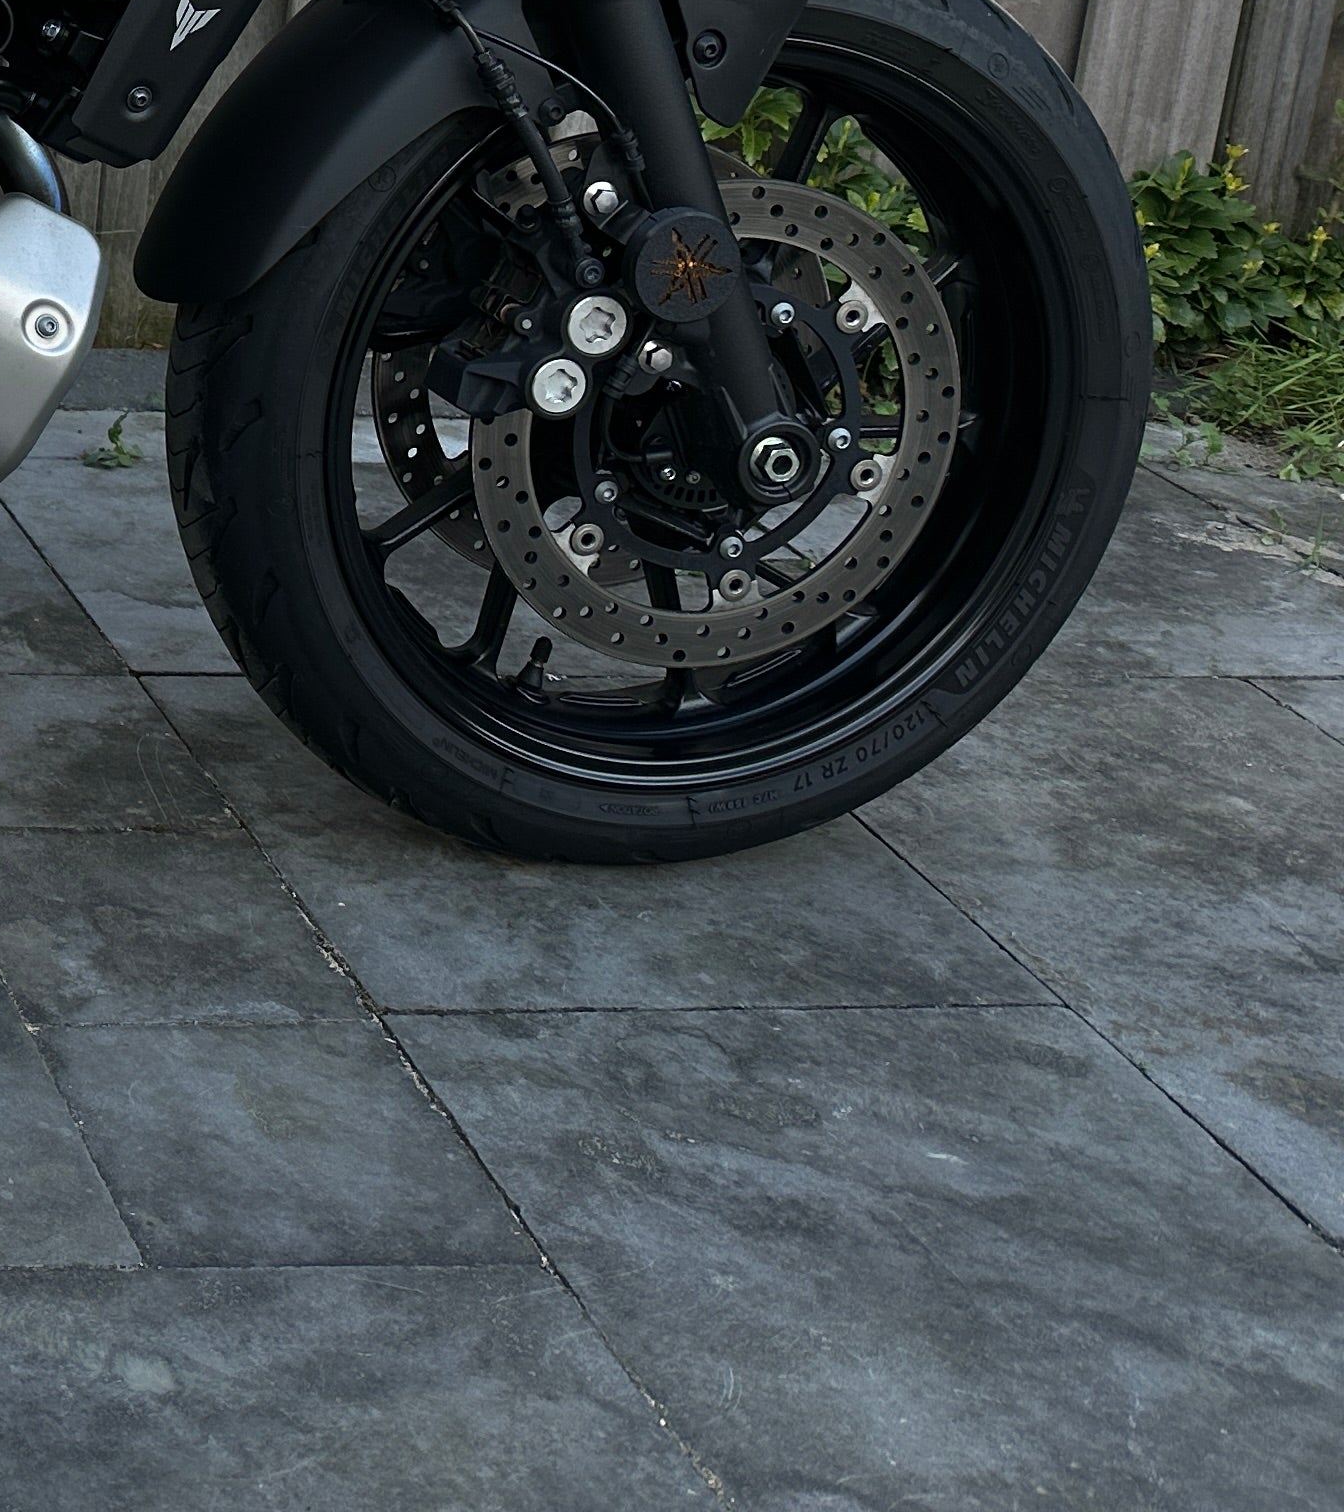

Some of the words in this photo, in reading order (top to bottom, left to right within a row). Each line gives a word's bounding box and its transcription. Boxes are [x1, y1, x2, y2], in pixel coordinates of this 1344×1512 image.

[954, 522, 1072, 688] MICHELIN
[855, 710, 926, 763] 120/70
[790, 771, 815, 792] 17
[821, 755, 850, 780] ZR
